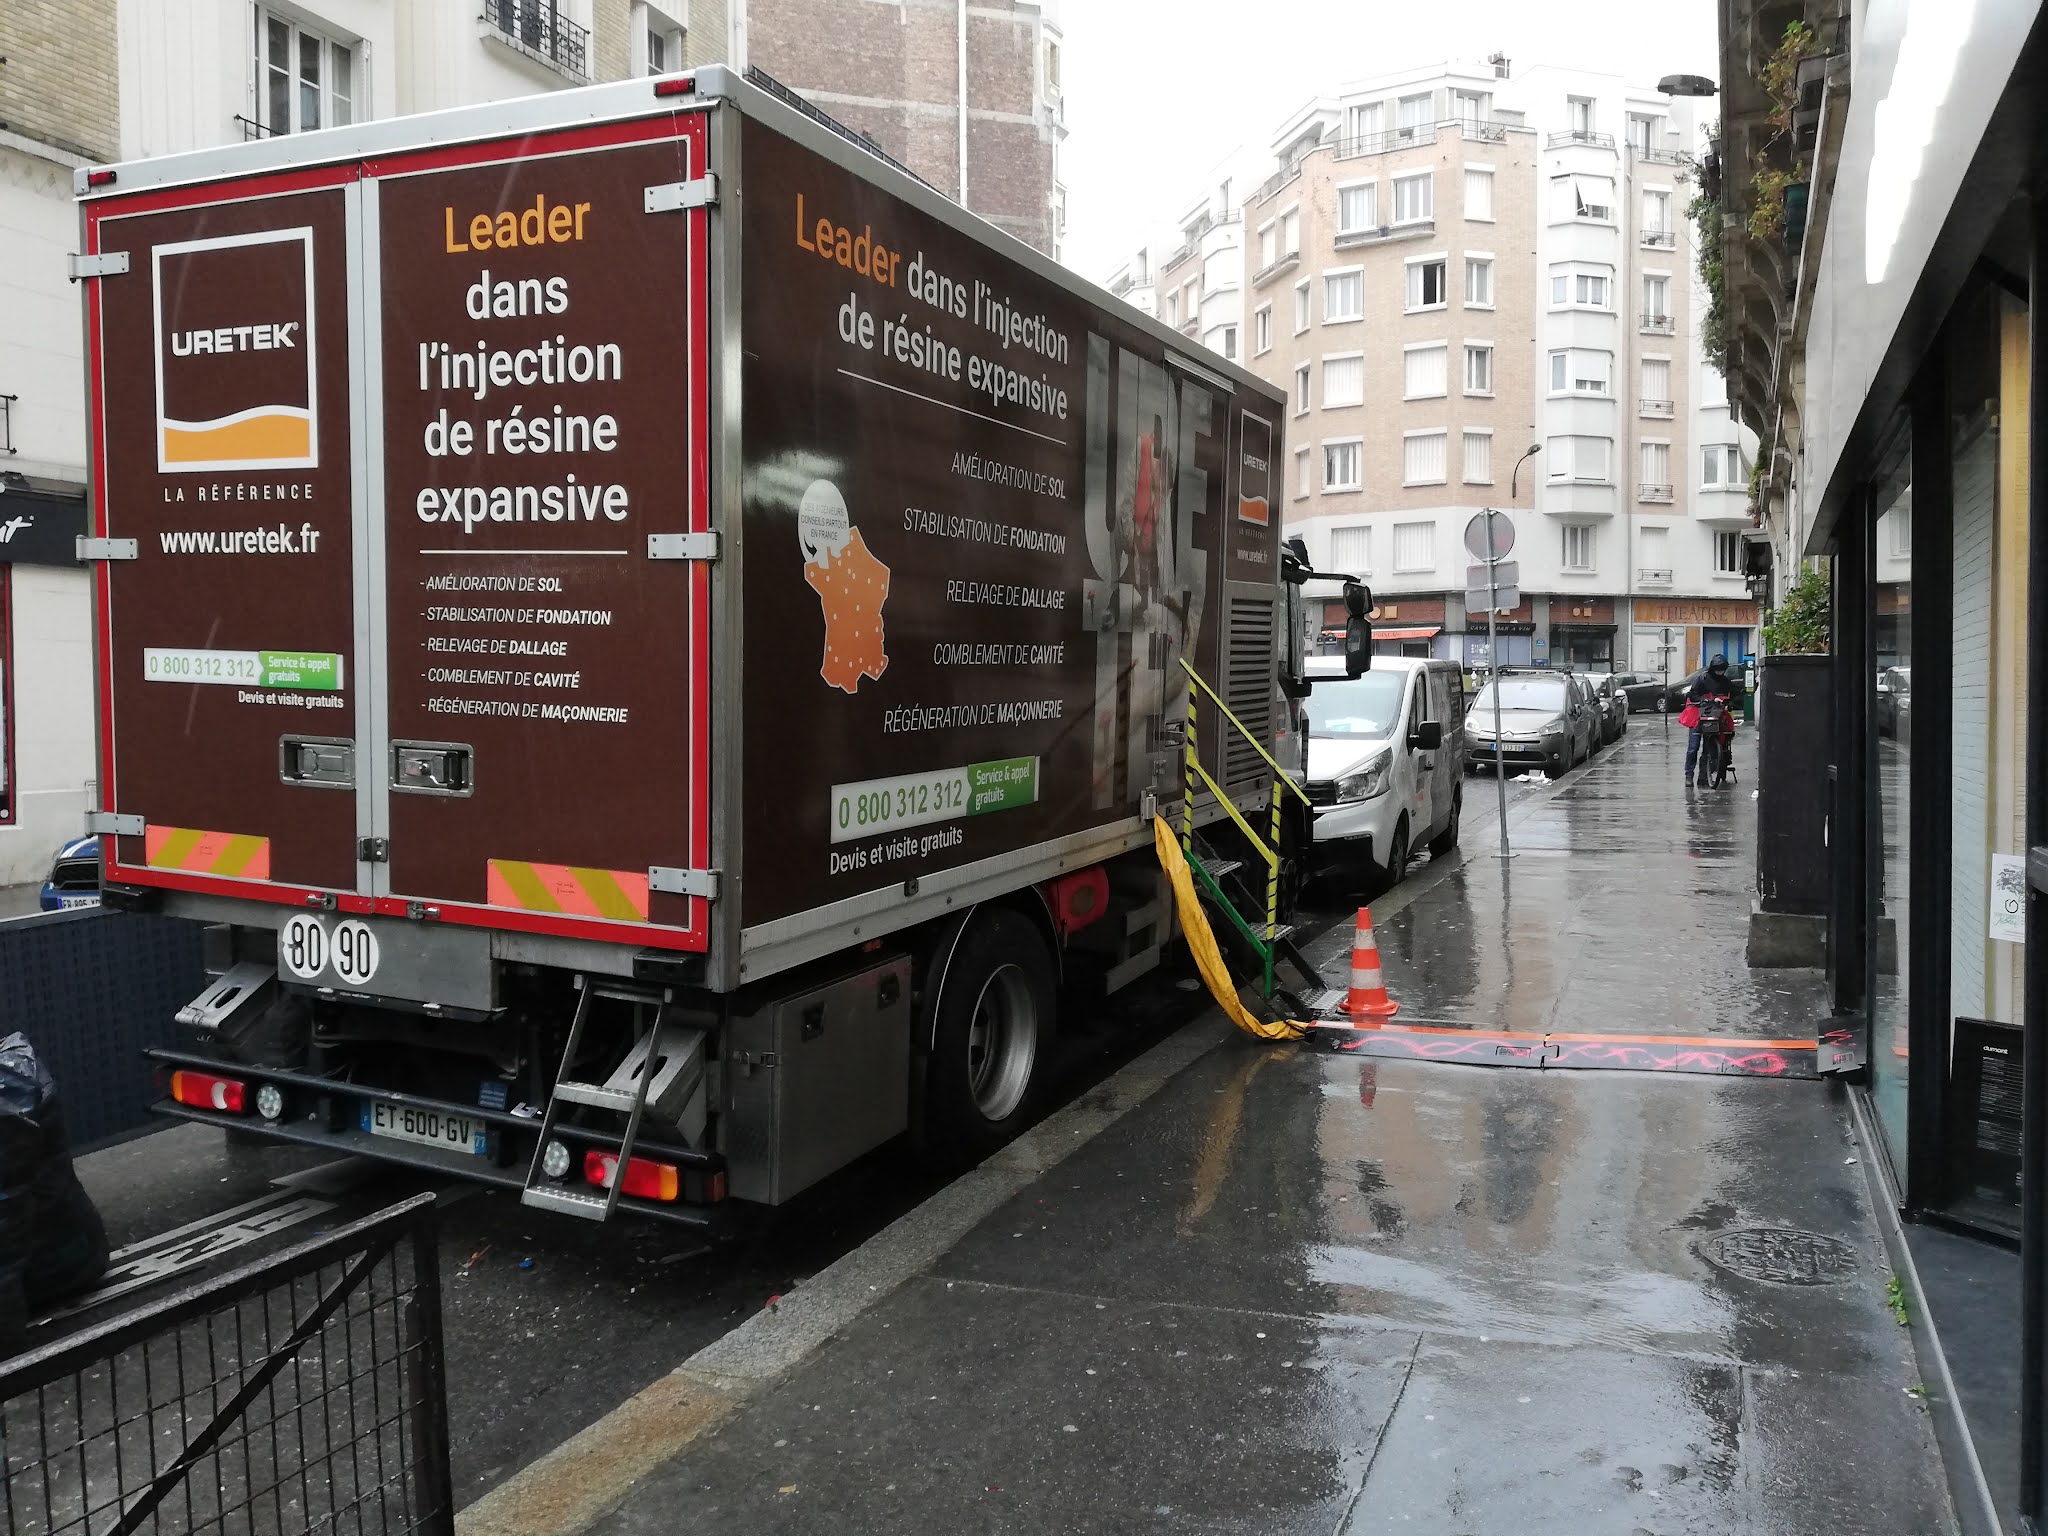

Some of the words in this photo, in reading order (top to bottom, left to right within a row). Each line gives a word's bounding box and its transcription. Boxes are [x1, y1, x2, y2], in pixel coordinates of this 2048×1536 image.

[446, 194, 591, 253] Leader
[796, 193, 900, 288] Leader
[908, 250, 966, 318] dans
[974, 279, 1068, 365] l'injection
[466, 270, 569, 320] dans
[172, 322, 295, 356] URETEK
[419, 335, 621, 400] l'injection
[838, 292, 874, 350] de
[884, 314, 961, 382] résine
[968, 355, 1067, 420] expansive
[424, 409, 473, 456] de
[487, 405, 618, 454] résine
[952, 452, 1031, 490] AMÉLIORATION
[1034, 475, 1047, 494] DE
[1048, 477, 1066, 500] SOL
[1244, 453, 1267, 472] URETEK
[164, 488, 184, 502] LA
[199, 483, 313, 501] RÉFÉRENCE
[417, 473, 628, 534] expansive
[161, 522, 319, 553] www.uretek.fr
[904, 508, 991, 543] STABILISATION
[994, 525, 1008, 545] DE
[1010, 527, 1065, 554] FONDATION
[426, 574, 515, 592] AMÉLIORATION
[518, 578, 535, 591] DE
[538, 578, 562, 592] SOL
[947, 580, 1004, 605] RELEVAGE
[1006, 586, 1020, 606] DE
[1022, 587, 1065, 610] DALLAGE
[427, 607, 514, 622] STABILISATION
[517, 609, 534, 623] DE
[536, 610, 611, 625] FONDATION
[428, 638, 488, 653] RELEVAGE
[490, 640, 507, 653] DE
[509, 641, 567, 656] DALLAGE
[934, 643, 1014, 664] COMBLEMENT
[1015, 646, 1029, 664] DE
[1031, 642, 1064, 664] CAVITÉ
[150, 657, 158, 673] 0
[164, 657, 189, 674] 800
[195, 658, 221, 676] 312
[227, 659, 254, 677] 312
[268, 656, 298, 669] Service
[307, 658, 330, 671] appel
[268, 671, 300, 684] gratuits
[428, 668, 512, 684] COMBLEMENT
[514, 672, 531, 686] DE
[533, 670, 580, 688] CAVITÉ
[238, 690, 264, 704] Devis
[266, 693, 276, 704] et
[278, 692, 304, 706] visite
[306, 694, 343, 709] gratuits
[522, 703, 539, 717] DE
[541, 704, 628, 723] MAÇONNERIE
[980, 704, 996, 723] DE
[997, 700, 1062, 727] MAÇONNERIE
[976, 766, 1002, 786] Service
[1005, 766, 1010, 780] &
[1011, 762, 1029, 782] appel
[839, 798, 849, 828] 0
[858, 790, 891, 825] 800
[897, 785, 927, 818] 312
[934, 779, 962, 814] 312
[976, 788, 1004, 811] gratuits
[830, 849, 866, 875] Devis
[870, 843, 883, 864] et
[886, 837, 918, 860] visite
[921, 826, 962, 857] gratuits
[291, 922, 321, 972] 80
[340, 926, 370, 978] 90
[375, 1104, 469, 1144] ET-600-GV
[475, 1134, 486, 1148] 77
